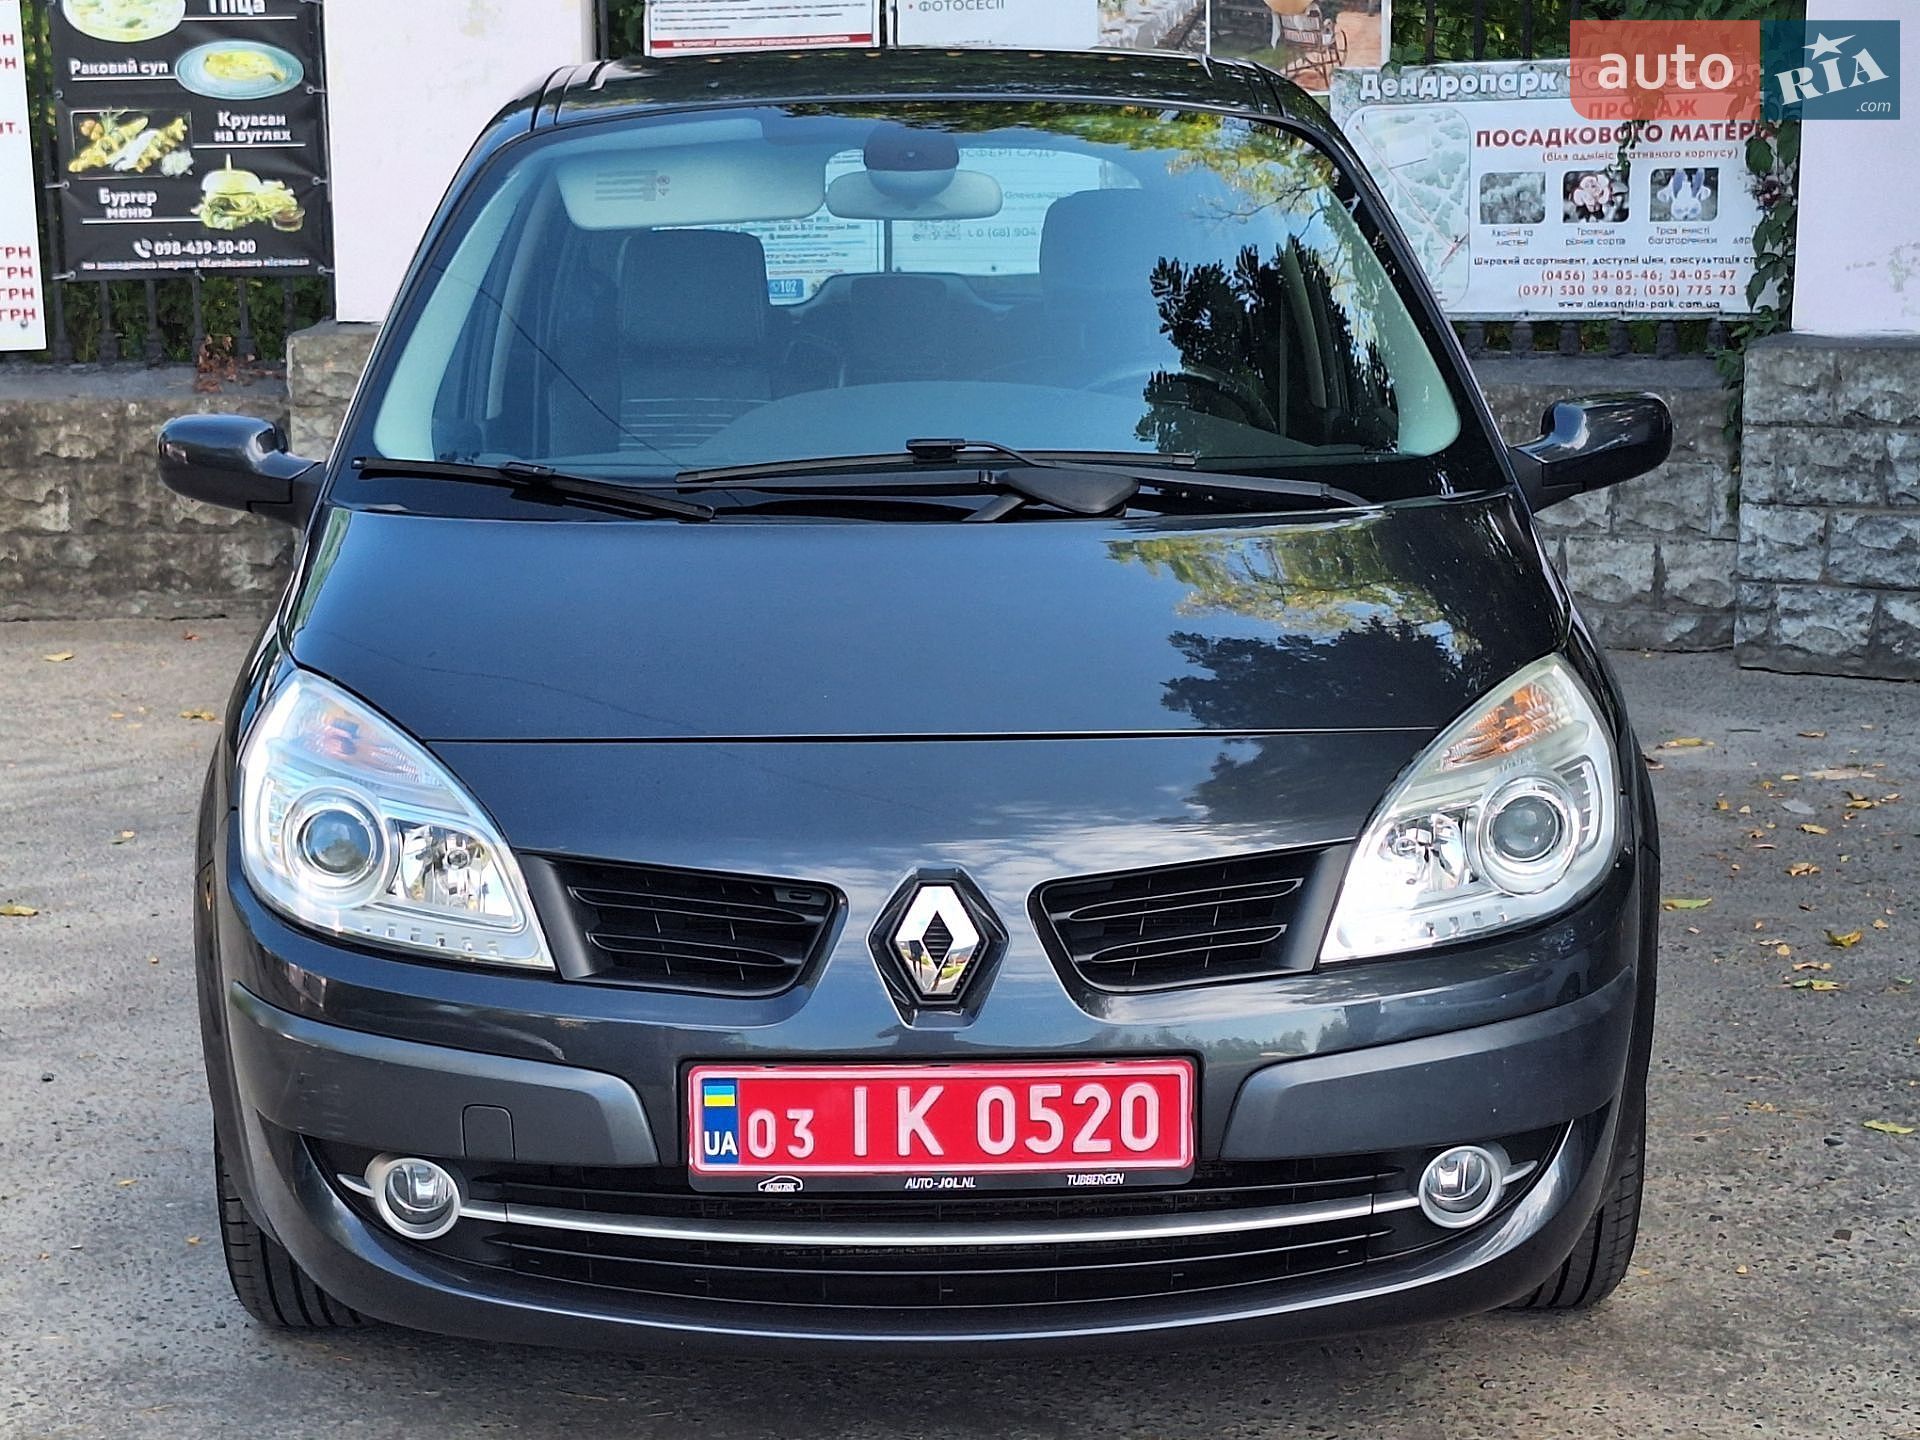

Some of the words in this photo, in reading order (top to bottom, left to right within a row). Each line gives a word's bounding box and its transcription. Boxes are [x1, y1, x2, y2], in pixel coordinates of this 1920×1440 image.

[70, 58, 138, 75] Раковий
[140, 61, 169, 76] суп
[1359, 69, 1559, 100] Дендропарк
[217, 110, 287, 130] Круасан
[1588, 100, 1698, 120] ПРОАЖ
[98, 187, 158, 207] Бургер
[105, 206, 152, 219] меню
[1541, 270, 1586, 282] (0456)
[1518, 285, 1554, 298] (097)
[1560, 285, 1586, 296] 530
[1643, 285, 1680, 297] (050)
[1687, 285, 1712, 295] 775
[746, 1108, 816, 1159] 03
[976, 1082, 1160, 1155] 0520
[704, 1131, 738, 1156] UA
[1066, 1172, 1125, 1187] TUBBERGEN
